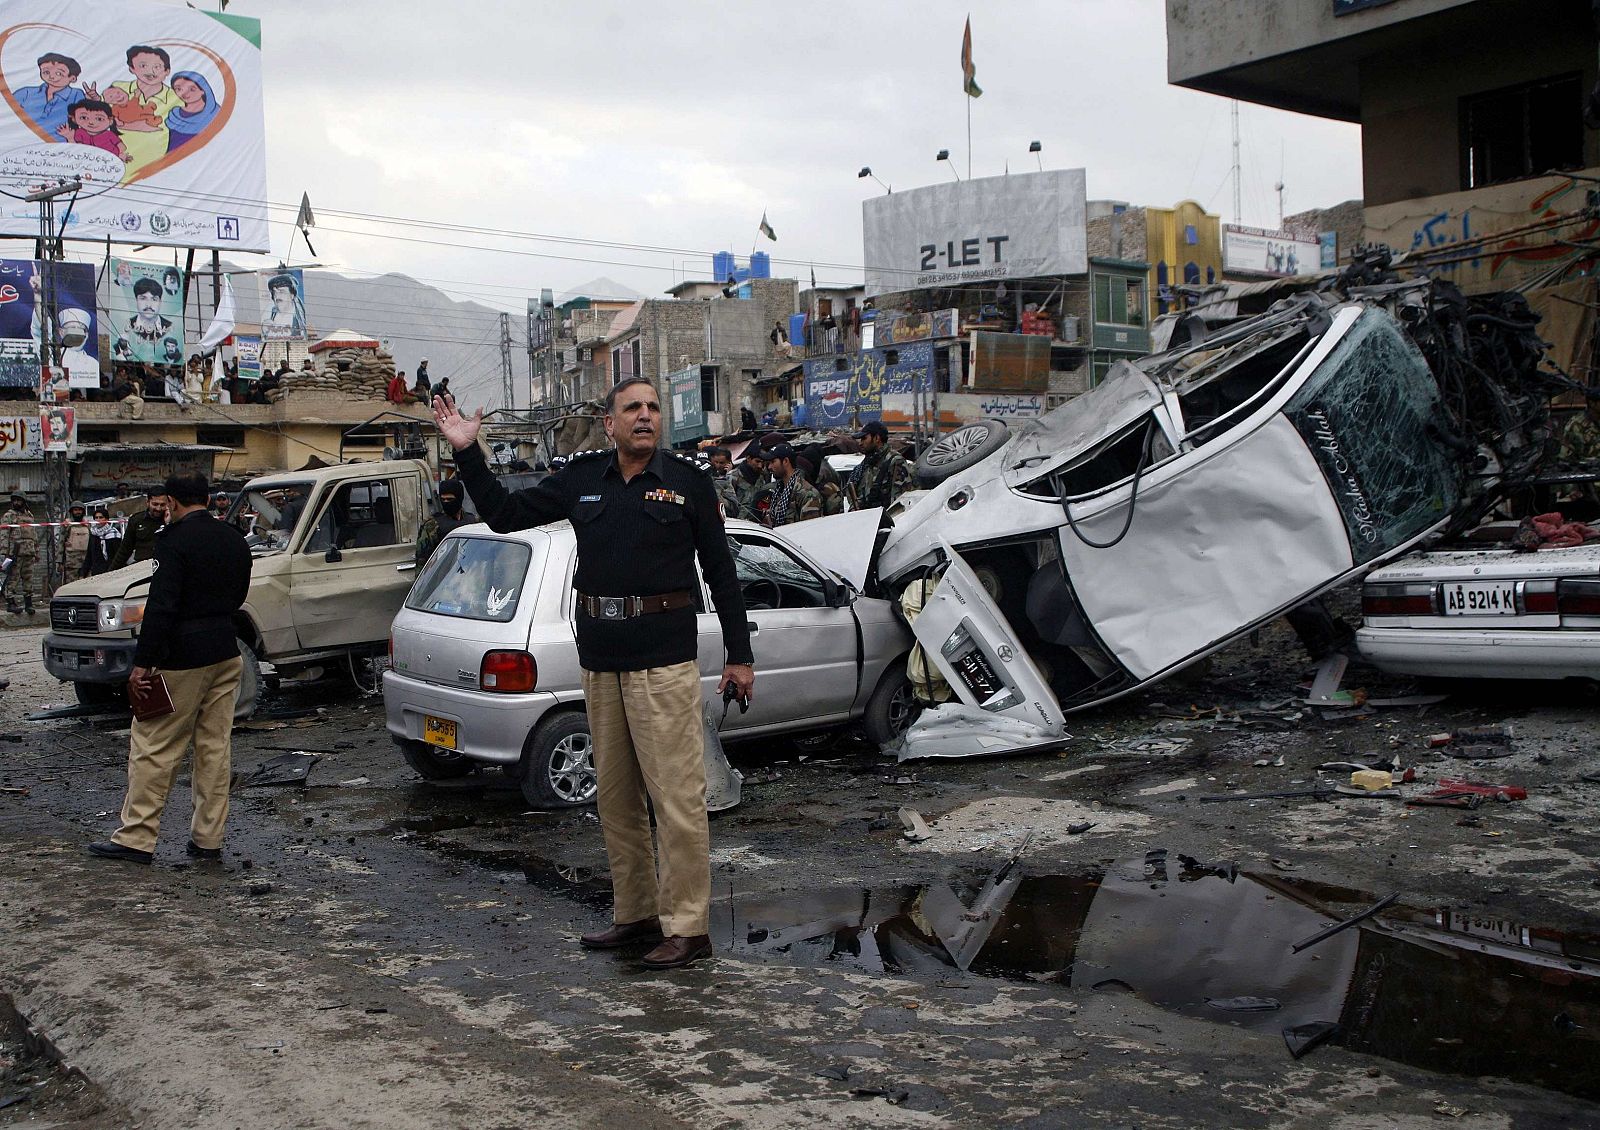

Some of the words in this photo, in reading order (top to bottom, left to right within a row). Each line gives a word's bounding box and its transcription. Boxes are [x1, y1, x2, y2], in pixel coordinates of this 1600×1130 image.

[809, 379, 849, 396] PEPSI
[1010, 396, 1042, 415] پاکستان
[1449, 591, 1465, 610] AB
[1469, 590, 1499, 610] 9214
[1504, 590, 1512, 609] K
